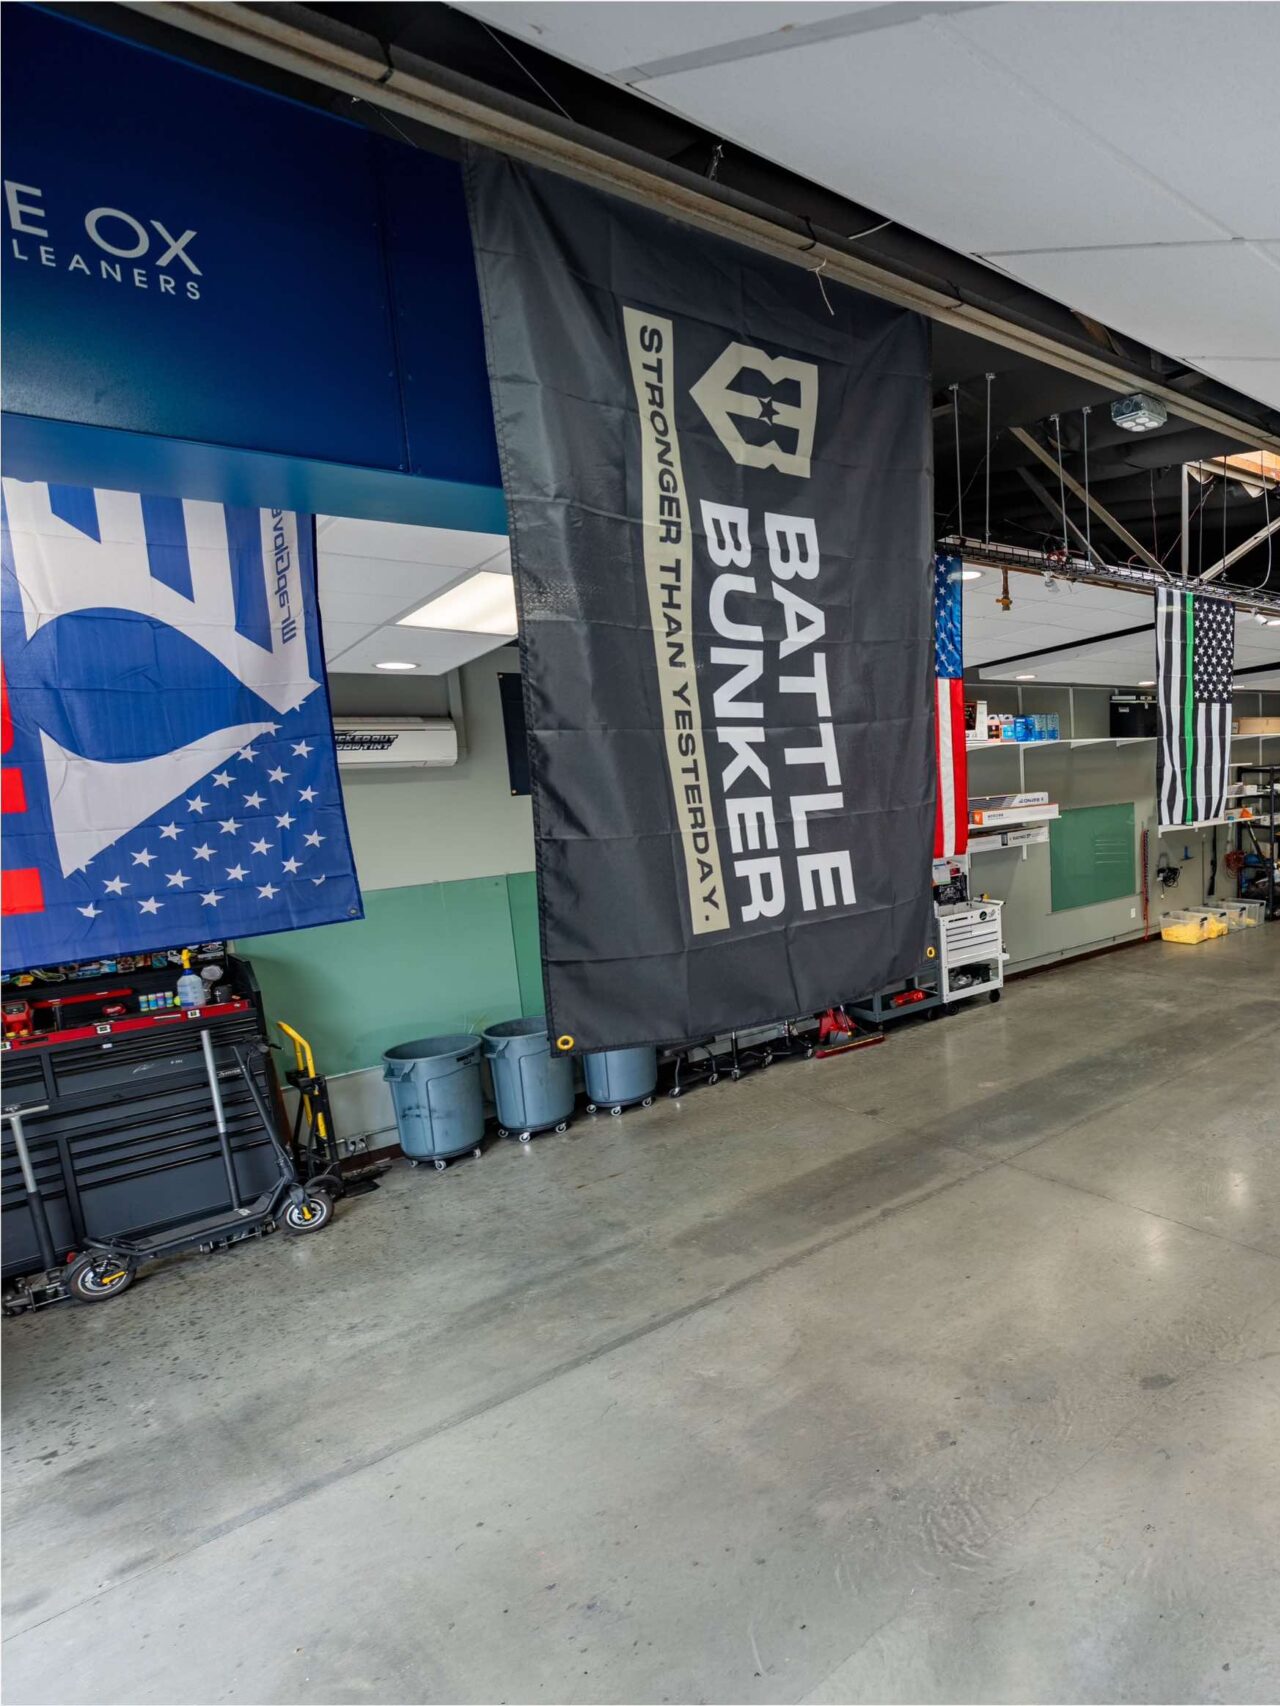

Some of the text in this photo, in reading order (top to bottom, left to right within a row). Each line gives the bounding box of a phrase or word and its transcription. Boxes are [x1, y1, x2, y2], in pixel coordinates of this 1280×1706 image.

[85, 207, 202, 275] OX
[639, 324, 720, 921] STRONGER THAN YESTERDAY.
[699, 499, 786, 923] BUNKER
[764, 512, 857, 912] BATTLE
